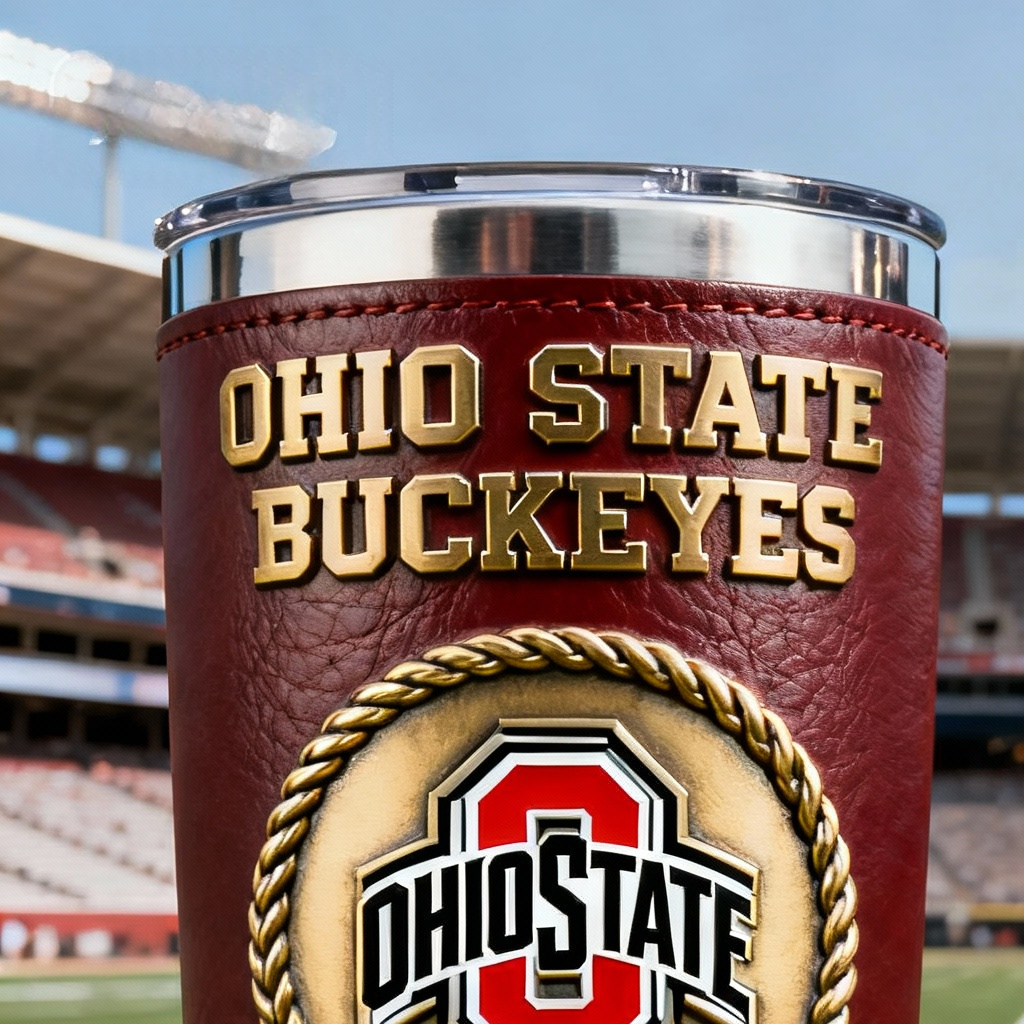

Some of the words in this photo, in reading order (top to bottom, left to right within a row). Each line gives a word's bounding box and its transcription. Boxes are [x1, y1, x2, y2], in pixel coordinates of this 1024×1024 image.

[219, 343, 481, 469] OHIO
[528, 343, 883, 470] STATE
[252, 471, 857, 586] BUCKEYES
